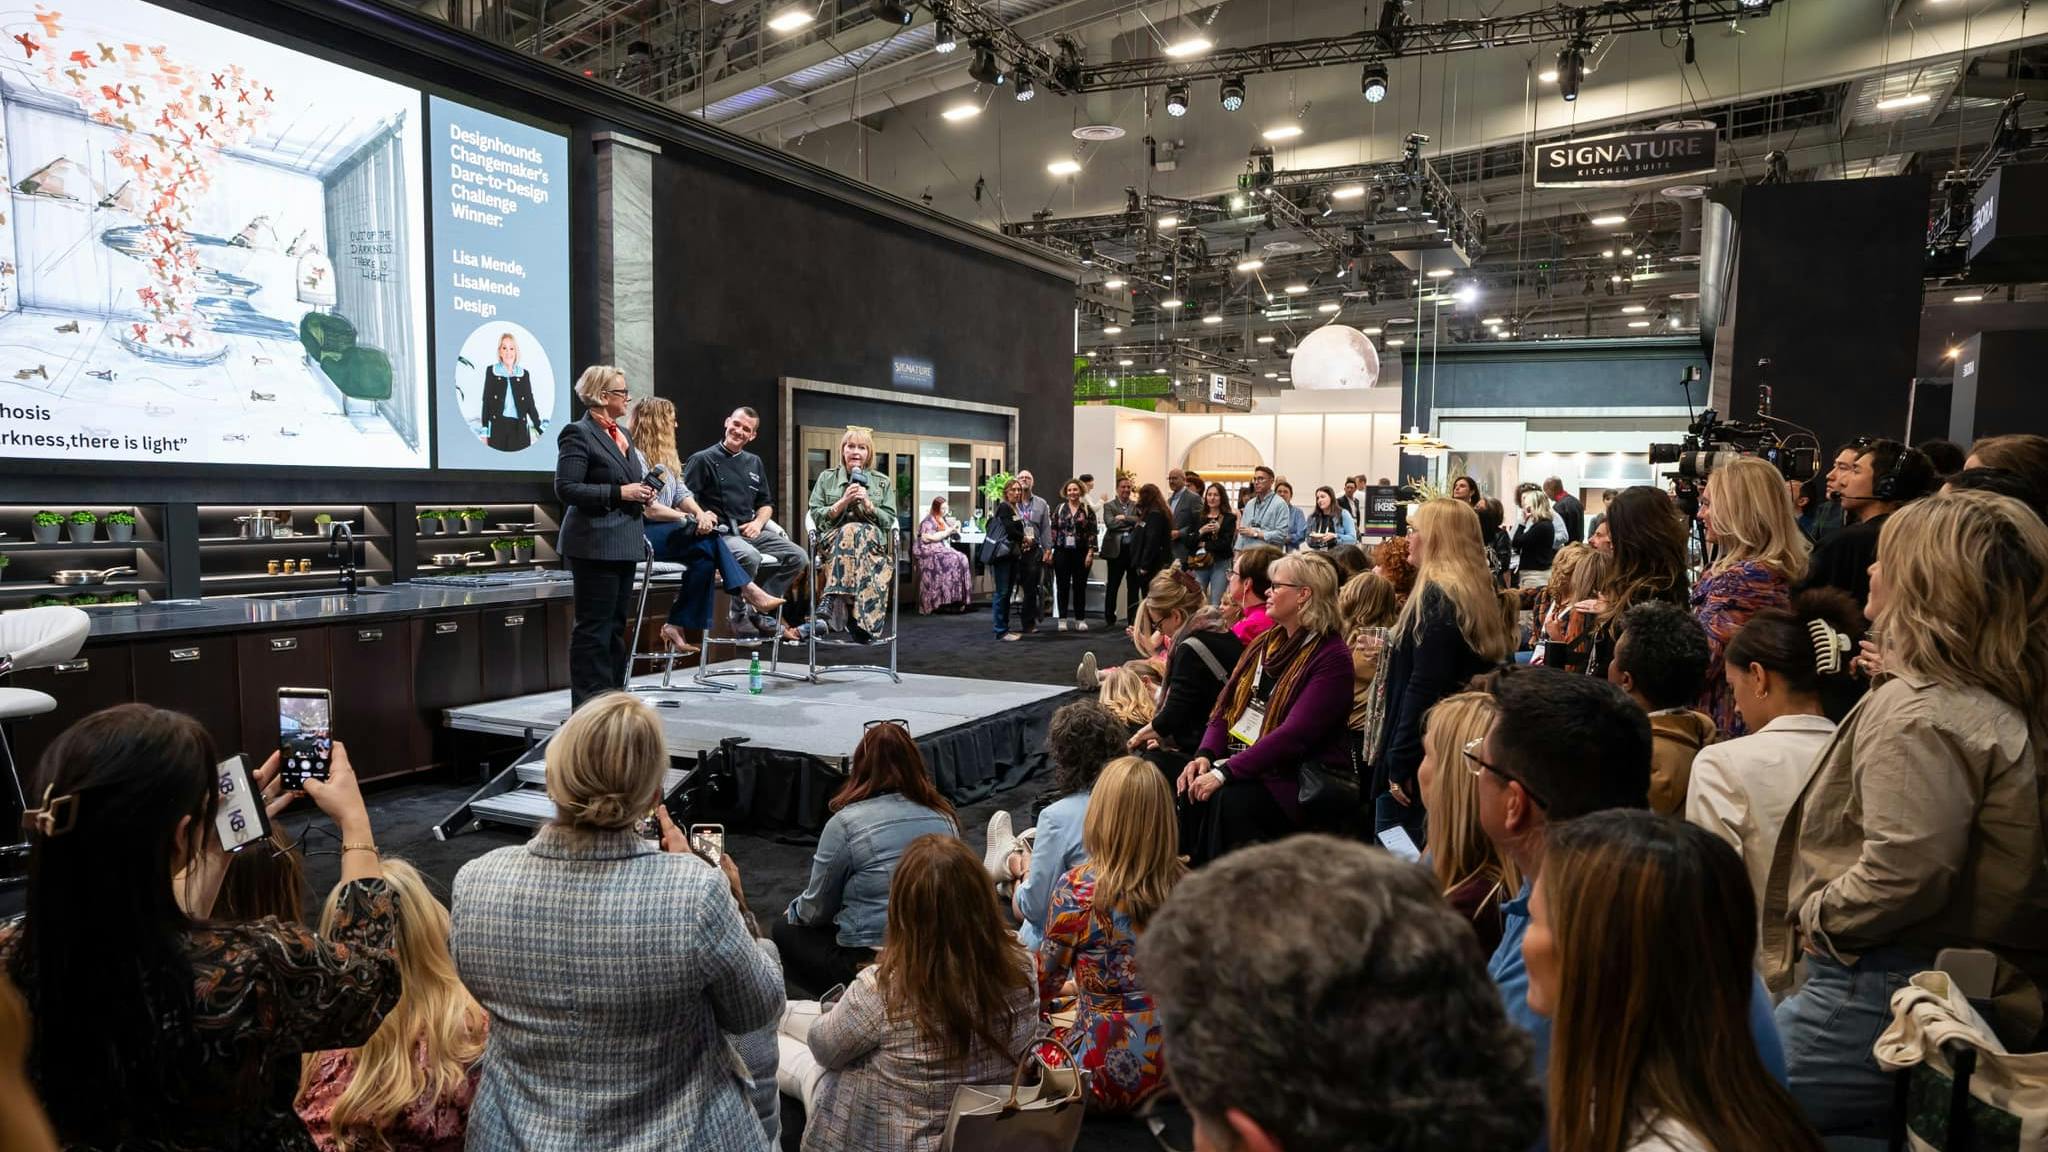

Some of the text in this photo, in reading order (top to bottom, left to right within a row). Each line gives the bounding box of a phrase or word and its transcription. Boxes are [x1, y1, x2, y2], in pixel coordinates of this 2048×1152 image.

[450, 123, 543, 164] Designhounds
[1550, 137, 1701, 167] SIGNATURE
[451, 163, 549, 203] Dare-to-Design
[1577, 162, 1671, 177] KITCHEN SUITE
[451, 183, 517, 214] Challenge
[451, 202, 503, 228] Winner:
[452, 248, 526, 278] Lisa Mende,
[453, 272, 520, 297] LisaMende
[453, 296, 496, 318] Design
[0, 430, 119, 451] rkness,there
[124, 435, 138, 449] is
